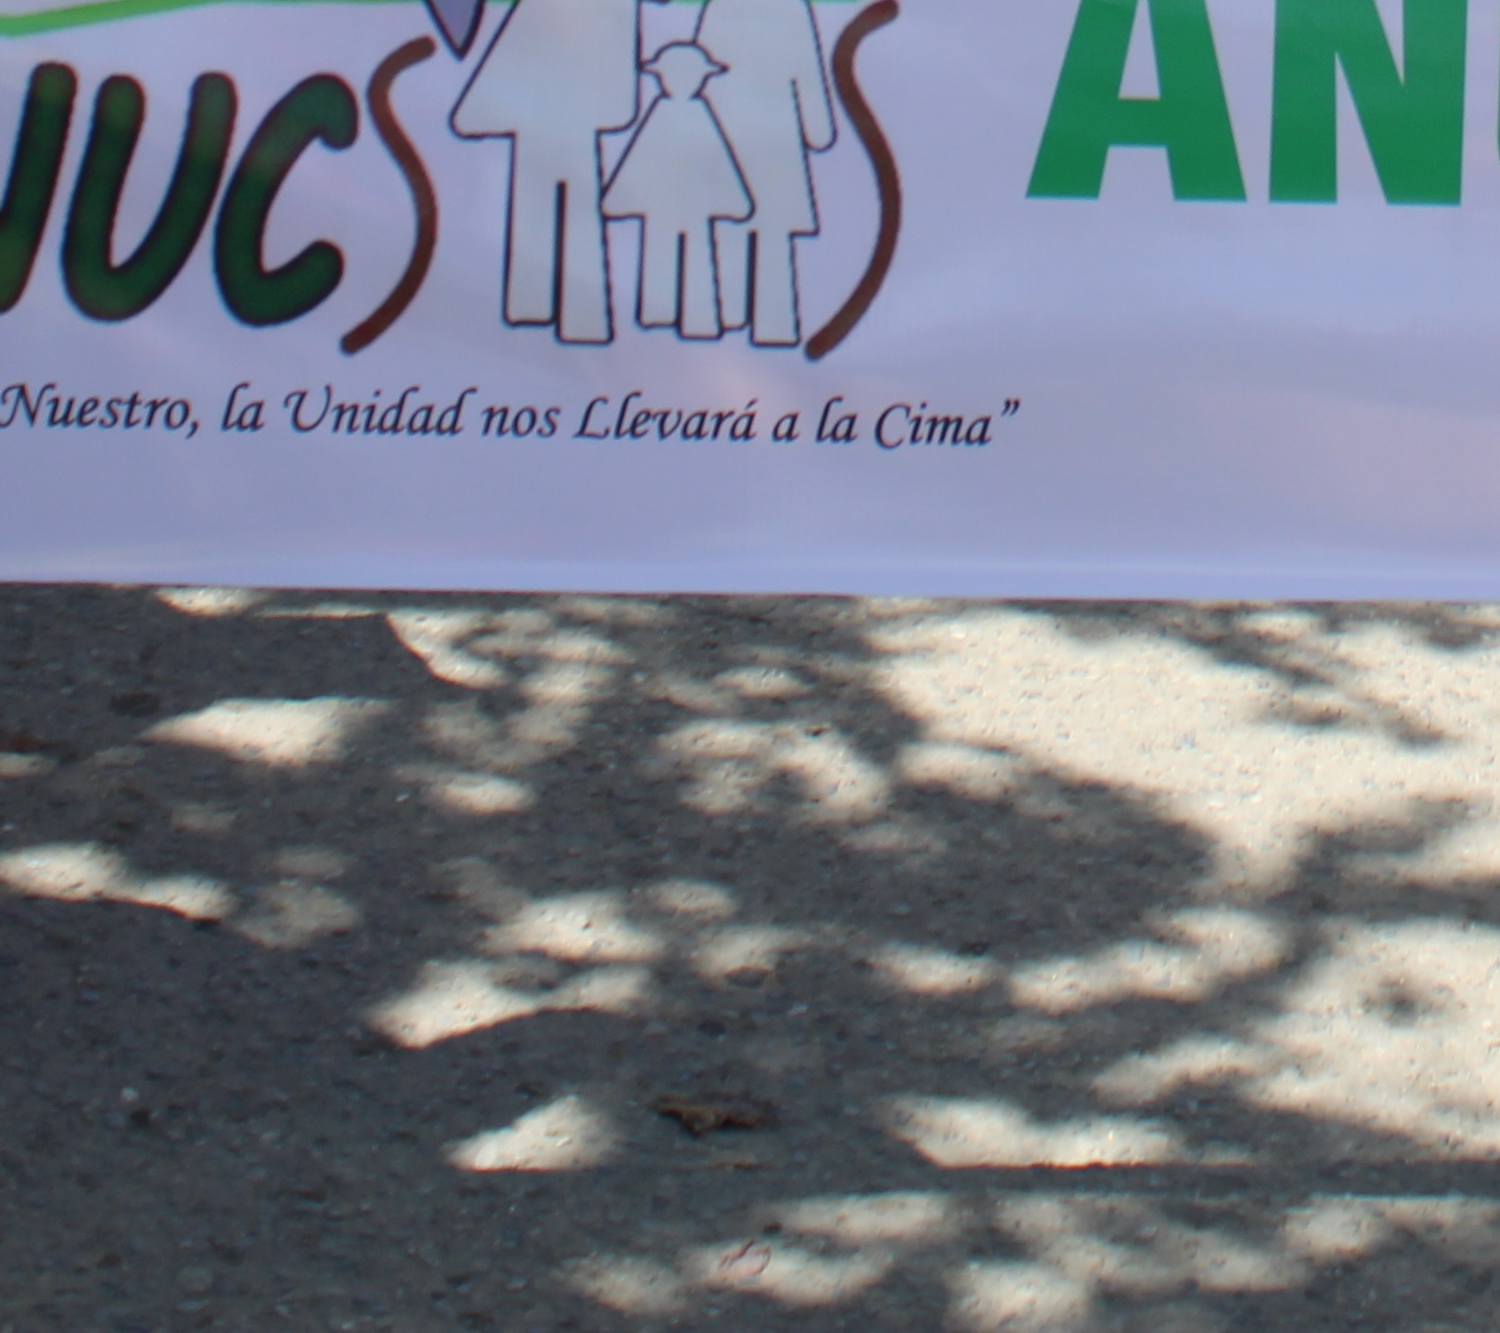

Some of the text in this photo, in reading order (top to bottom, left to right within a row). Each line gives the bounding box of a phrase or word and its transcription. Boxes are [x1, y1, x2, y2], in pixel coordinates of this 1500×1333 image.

[219, 381, 265, 433] la
[282, 383, 477, 438] Unidad
[480, 399, 561, 440] nos
[573, 391, 760, 443] Llevará
[770, 413, 800, 444] a
[814, 395, 860, 445] la
